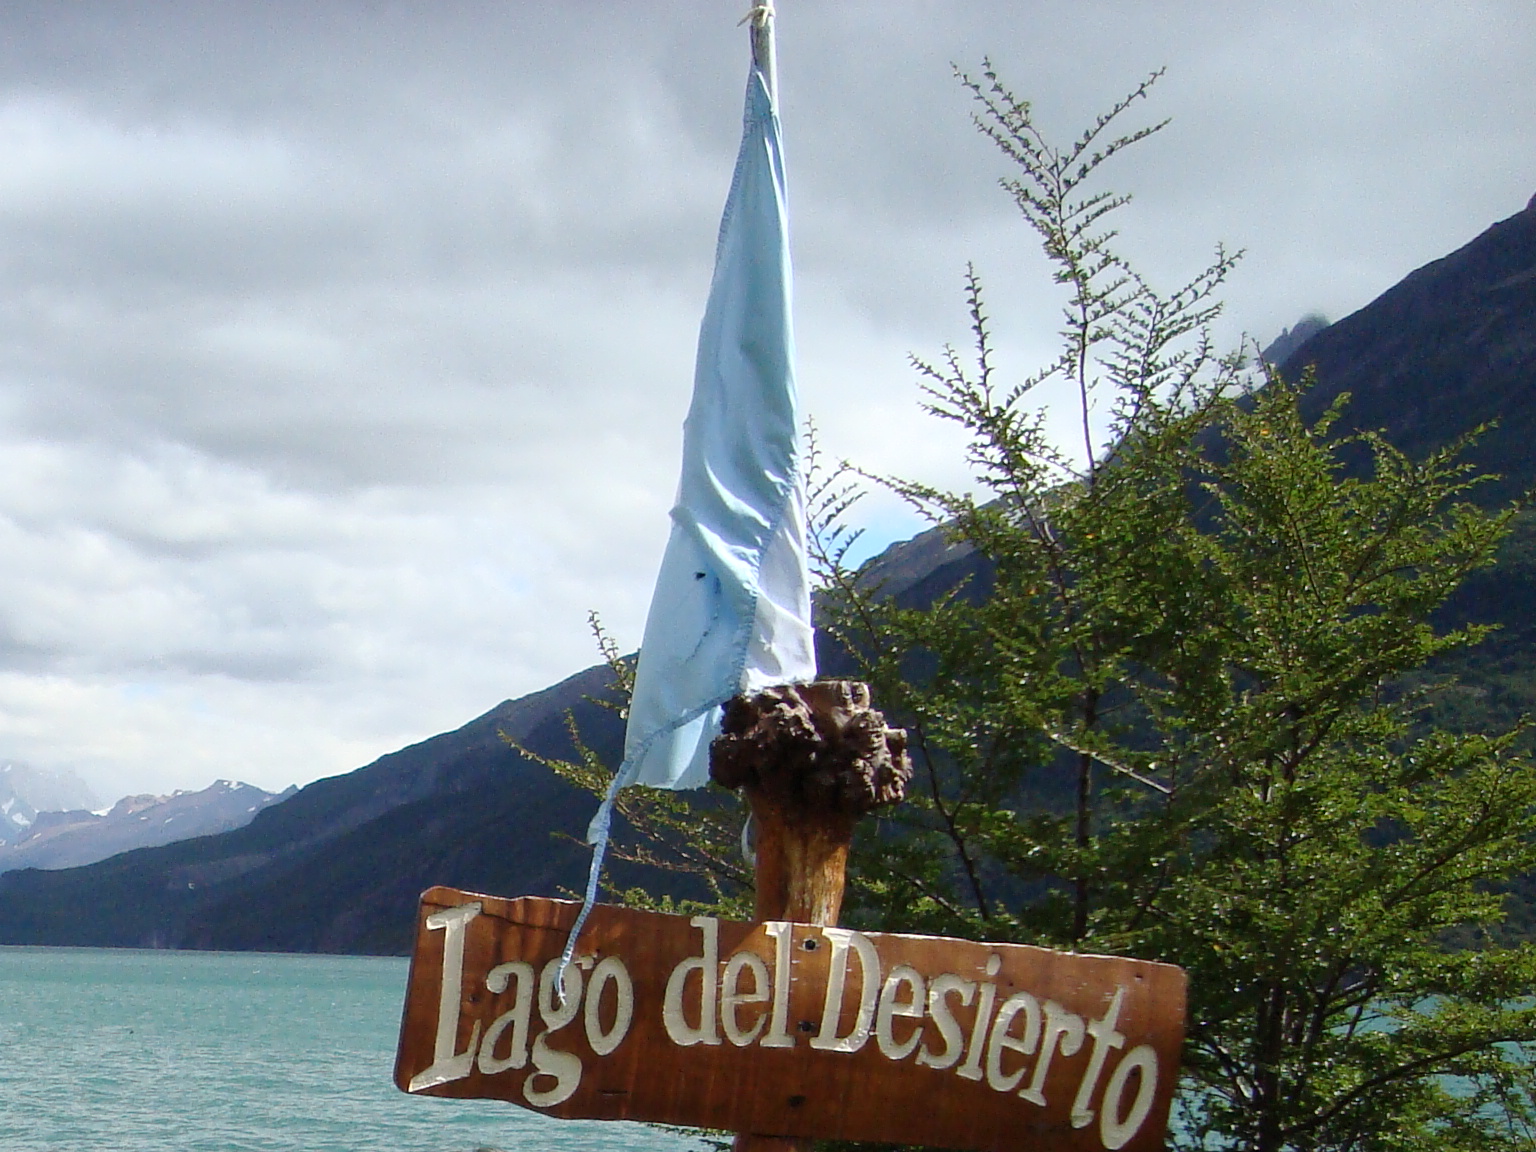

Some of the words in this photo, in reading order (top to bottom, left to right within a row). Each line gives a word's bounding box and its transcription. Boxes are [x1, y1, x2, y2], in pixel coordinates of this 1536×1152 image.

[408, 901, 634, 1107] Lago
[662, 916, 796, 1049] del
[810, 925, 1159, 1151] Desierto
